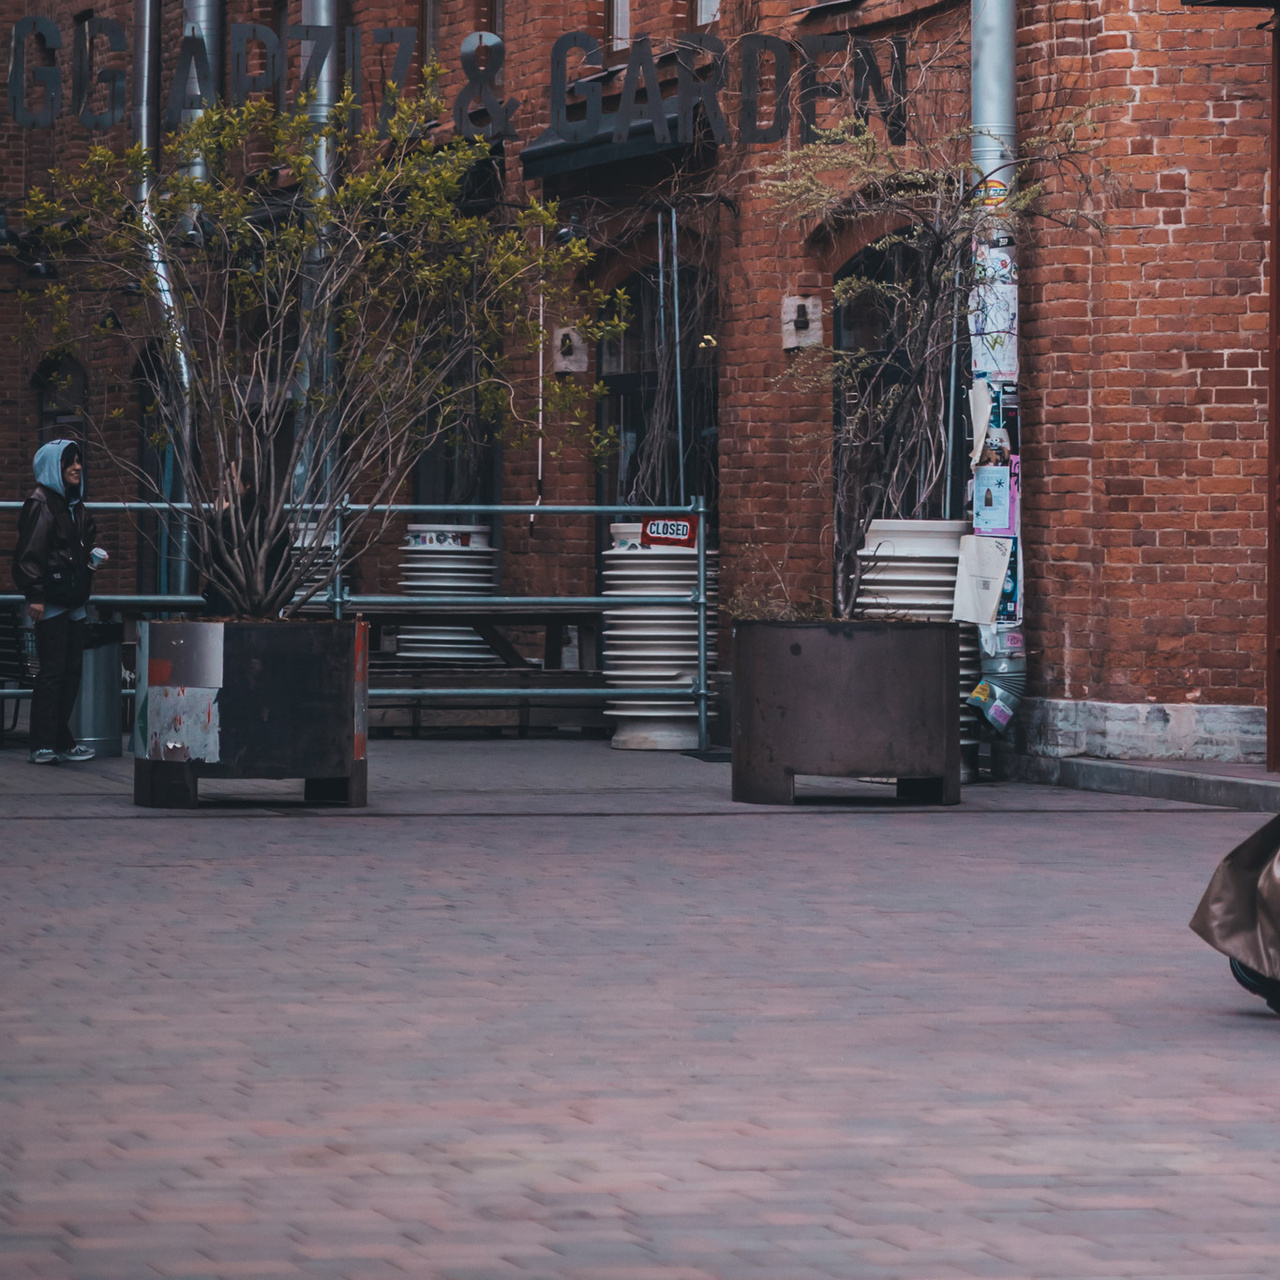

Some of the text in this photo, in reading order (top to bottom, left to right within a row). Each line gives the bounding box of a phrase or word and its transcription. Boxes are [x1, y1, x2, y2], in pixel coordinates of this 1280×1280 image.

[453, 31, 521, 142] &
[551, 31, 907, 147] GARDEN
[649, 522, 689, 537] CLOSED
